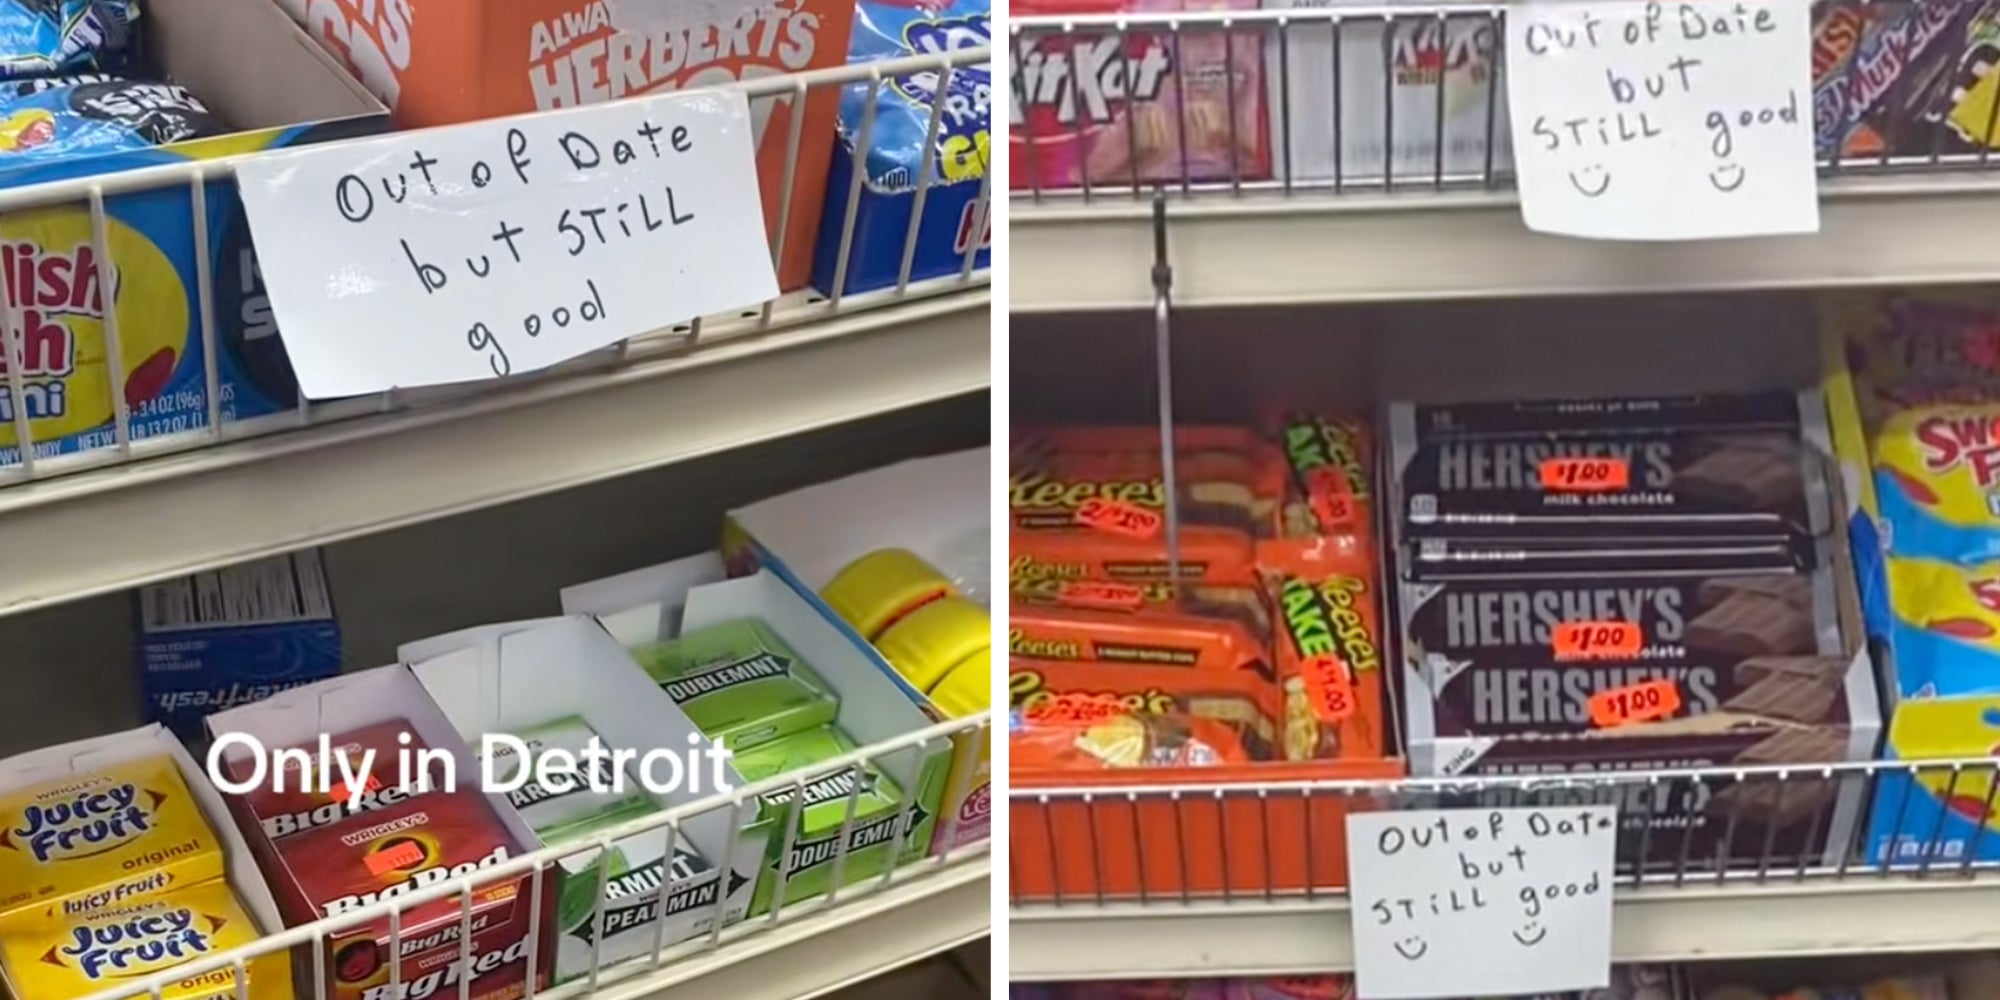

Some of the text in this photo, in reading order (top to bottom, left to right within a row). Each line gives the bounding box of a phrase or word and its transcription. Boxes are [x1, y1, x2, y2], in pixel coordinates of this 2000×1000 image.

[1526, 3, 1776, 55] Out of Date
[1607, 56, 1702, 103] but
[1706, 90, 1798, 158] good
[336, 121, 694, 223] Out of Date
[401, 221, 524, 294] but
[468, 279, 606, 376] good
[1570, 627, 1625, 650] $1.00
[667, 655, 783, 702] OUBLEMINT
[1607, 687, 1660, 717] $1.00
[14, 783, 135, 837] Juicy
[31, 806, 149, 862] Fruit
[121, 839, 200, 871] original
[1459, 846, 1526, 880] but
[1519, 873, 1599, 917] good
[62, 908, 192, 955] Juicy
[80, 929, 207, 979] Fruit
